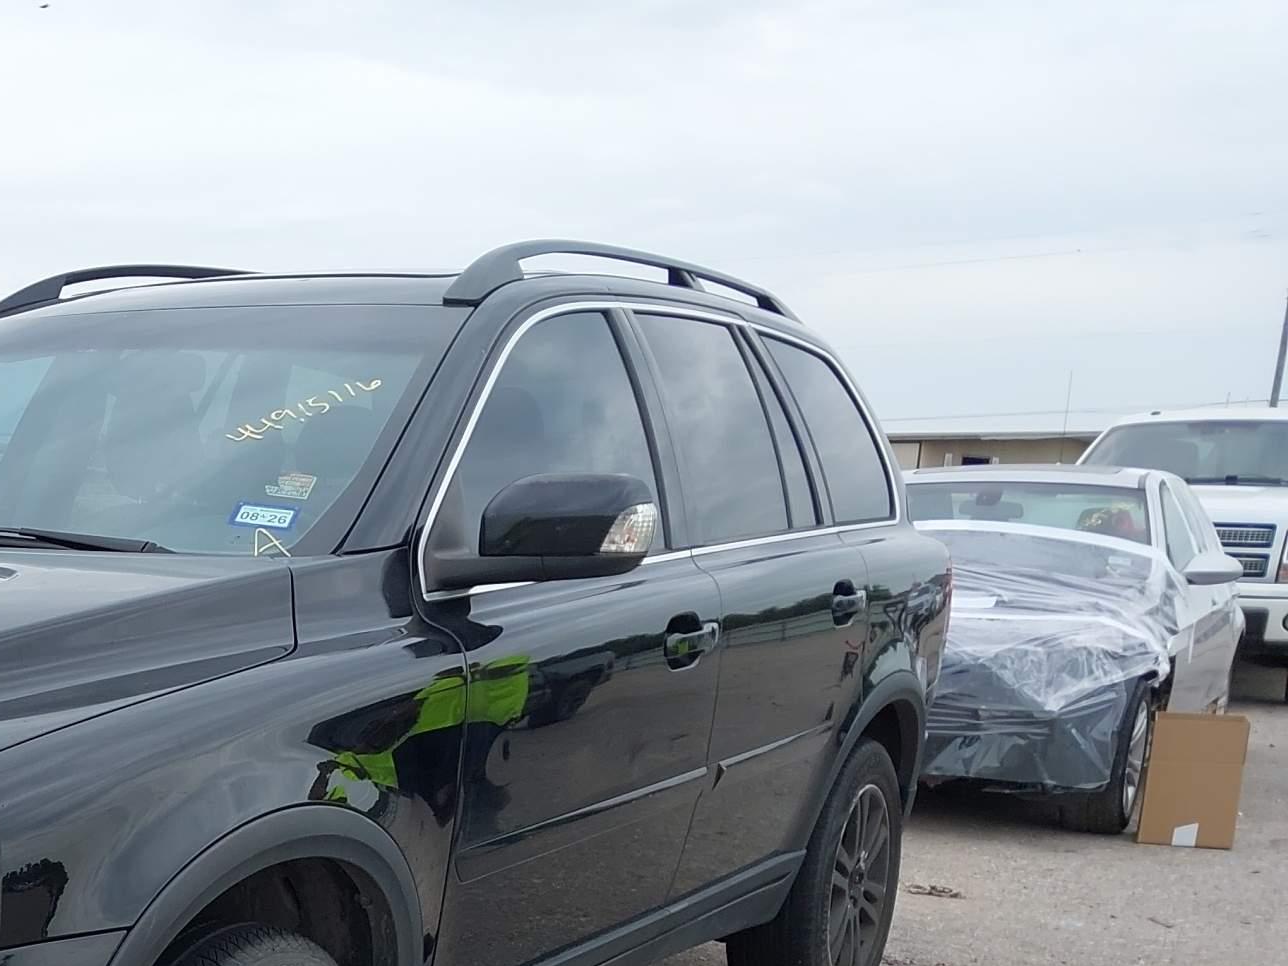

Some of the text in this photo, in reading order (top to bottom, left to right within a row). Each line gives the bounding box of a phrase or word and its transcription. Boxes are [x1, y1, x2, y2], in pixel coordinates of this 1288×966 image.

[225, 379, 382, 442] 44915116
[240, 511, 260, 521] 08
[267, 514, 288, 524] 26
[254, 527, 292, 558] A
